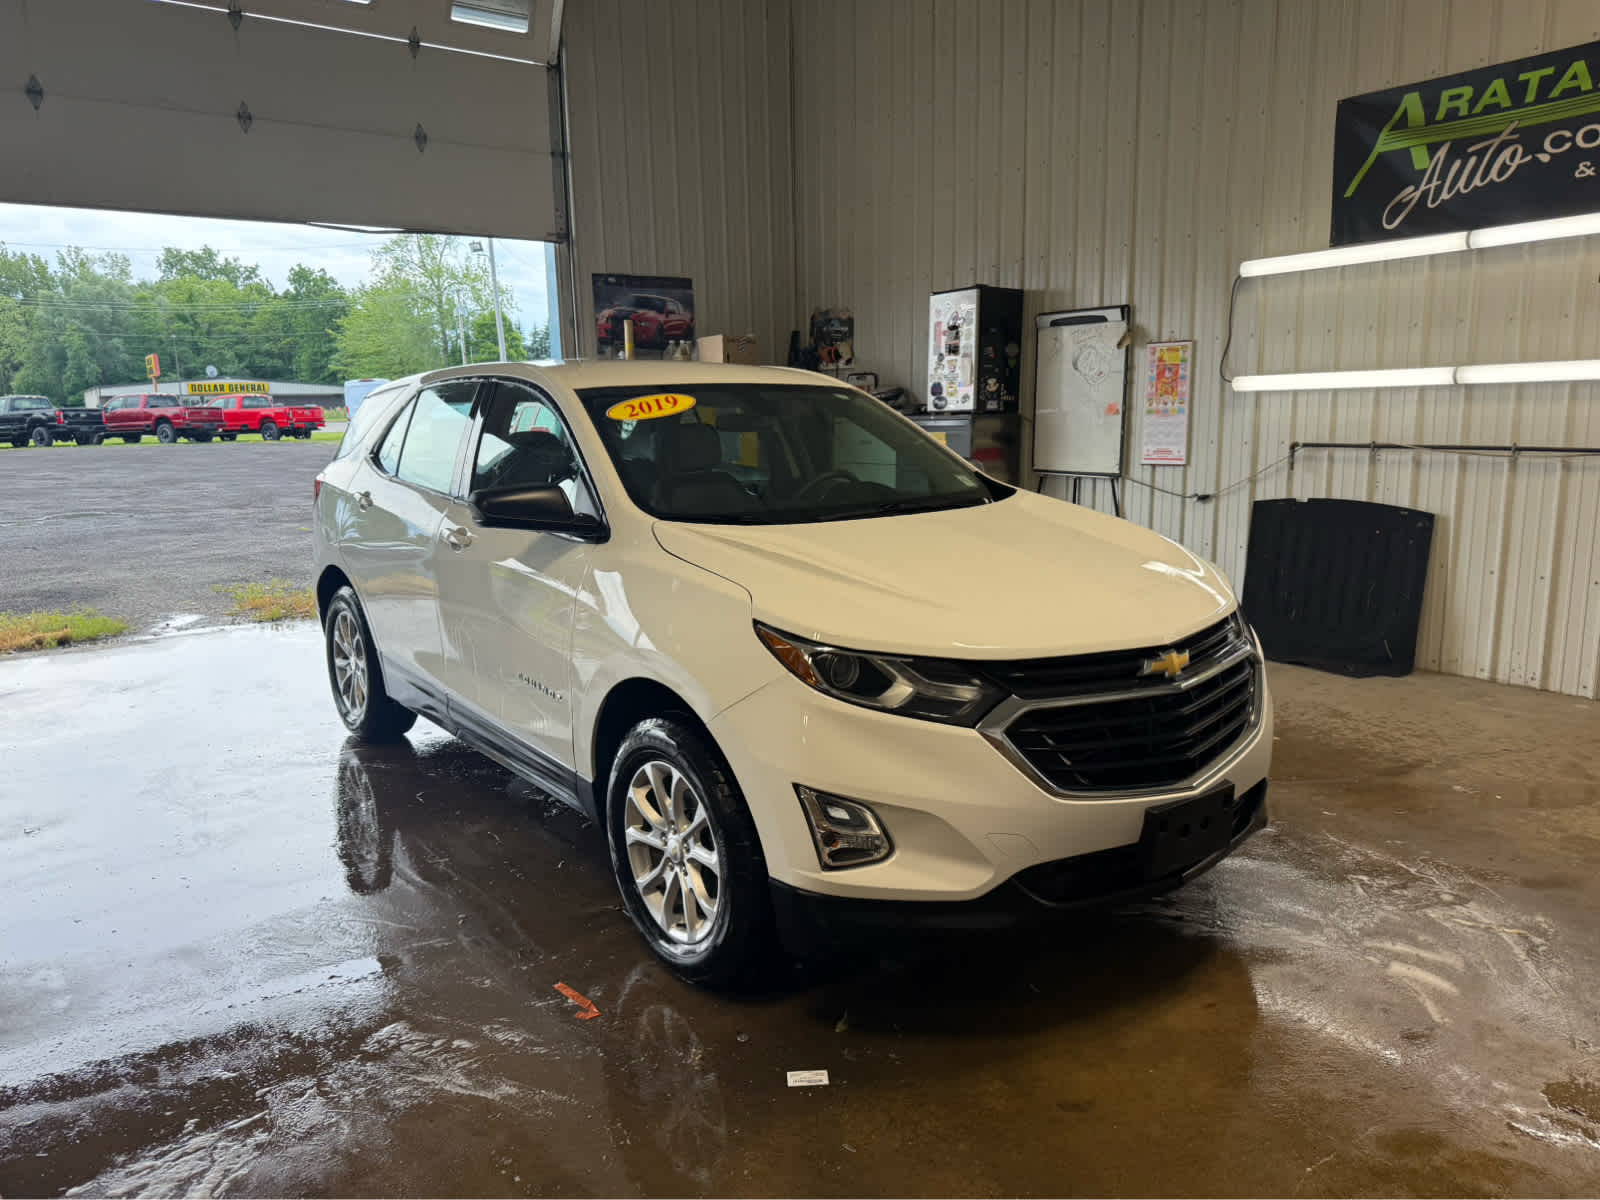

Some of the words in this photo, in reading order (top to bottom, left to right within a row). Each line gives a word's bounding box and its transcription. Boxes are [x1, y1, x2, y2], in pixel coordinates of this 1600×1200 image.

[1344, 60, 1600, 198] ARATA
[1574, 161, 1597, 178] &
[191, 383, 226, 394] DOLLAR
[228, 383, 267, 394] GENERAL
[624, 394, 679, 418] 2019
